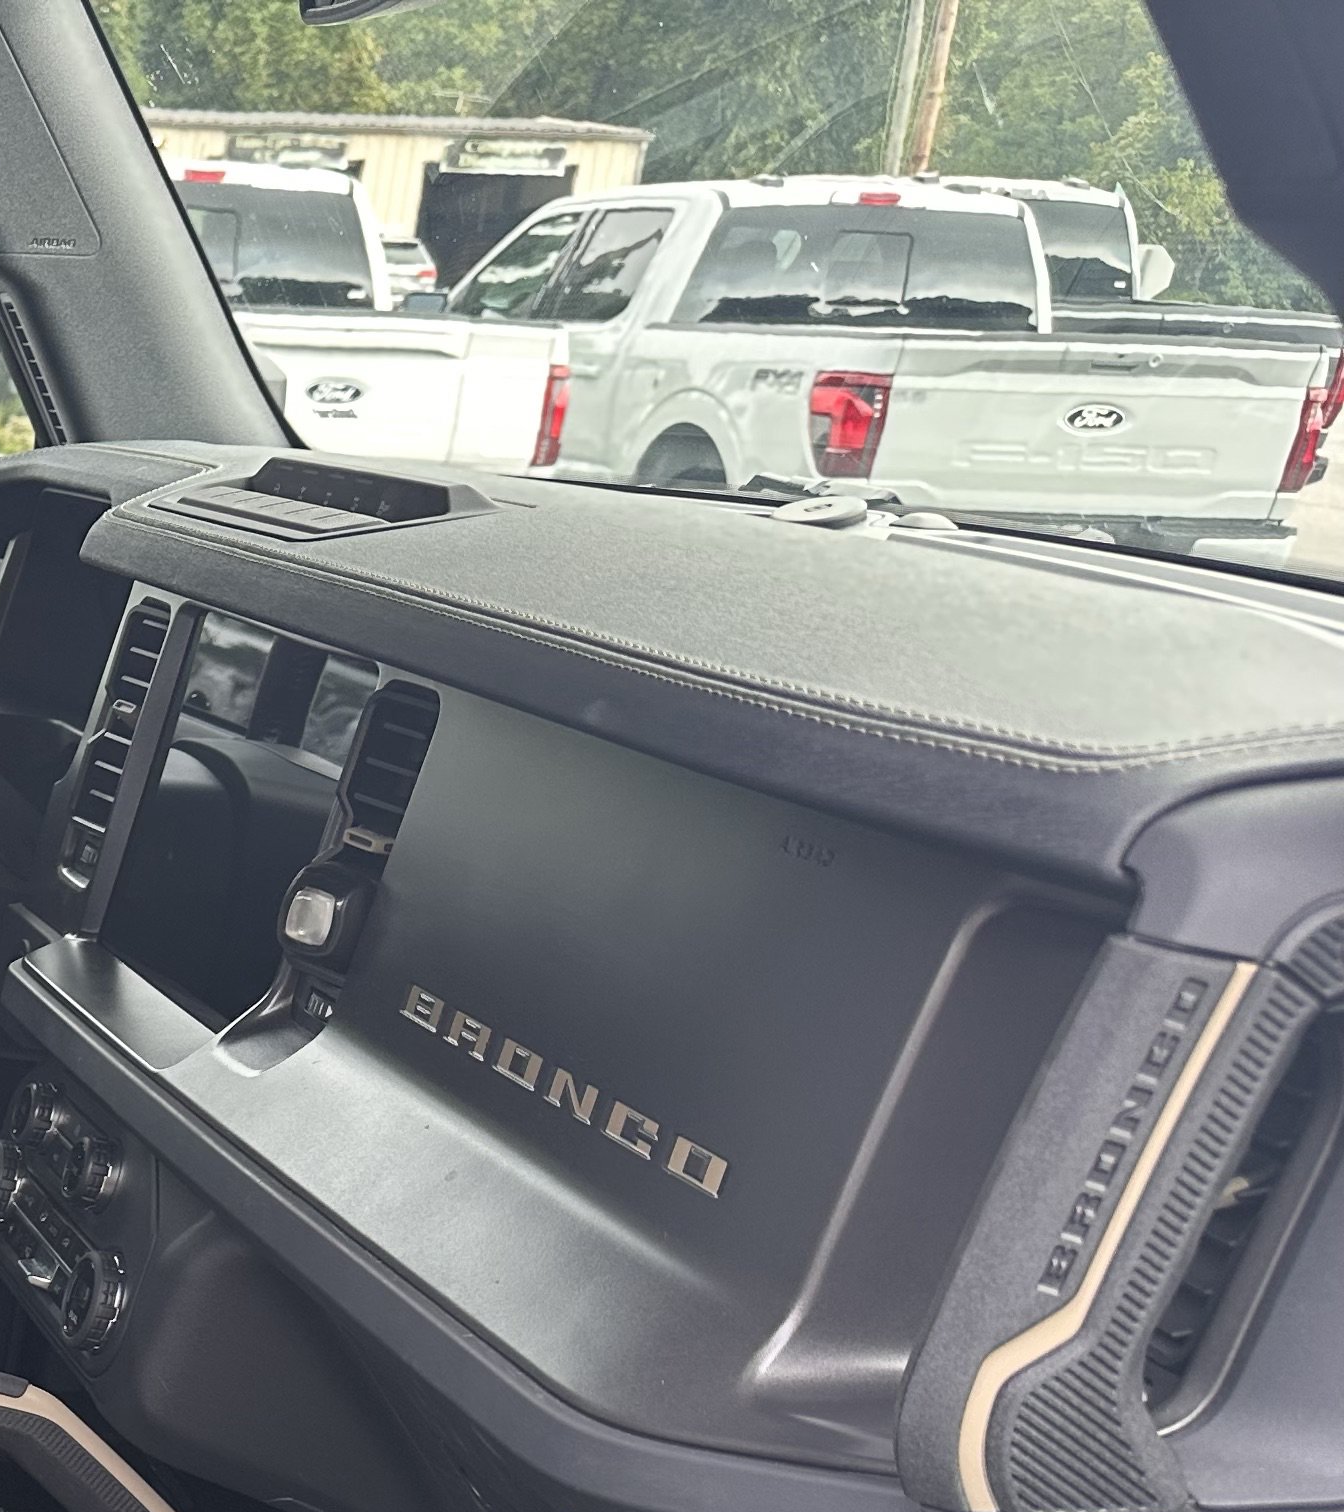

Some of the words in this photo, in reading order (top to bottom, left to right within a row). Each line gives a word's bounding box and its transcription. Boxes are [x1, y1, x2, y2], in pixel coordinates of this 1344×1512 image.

[951, 441, 1217, 476] F-150
[1070, 407, 1121, 430] Ford
[399, 982, 731, 1200] BRONCO
[1037, 976, 1210, 1297] BRONCO
